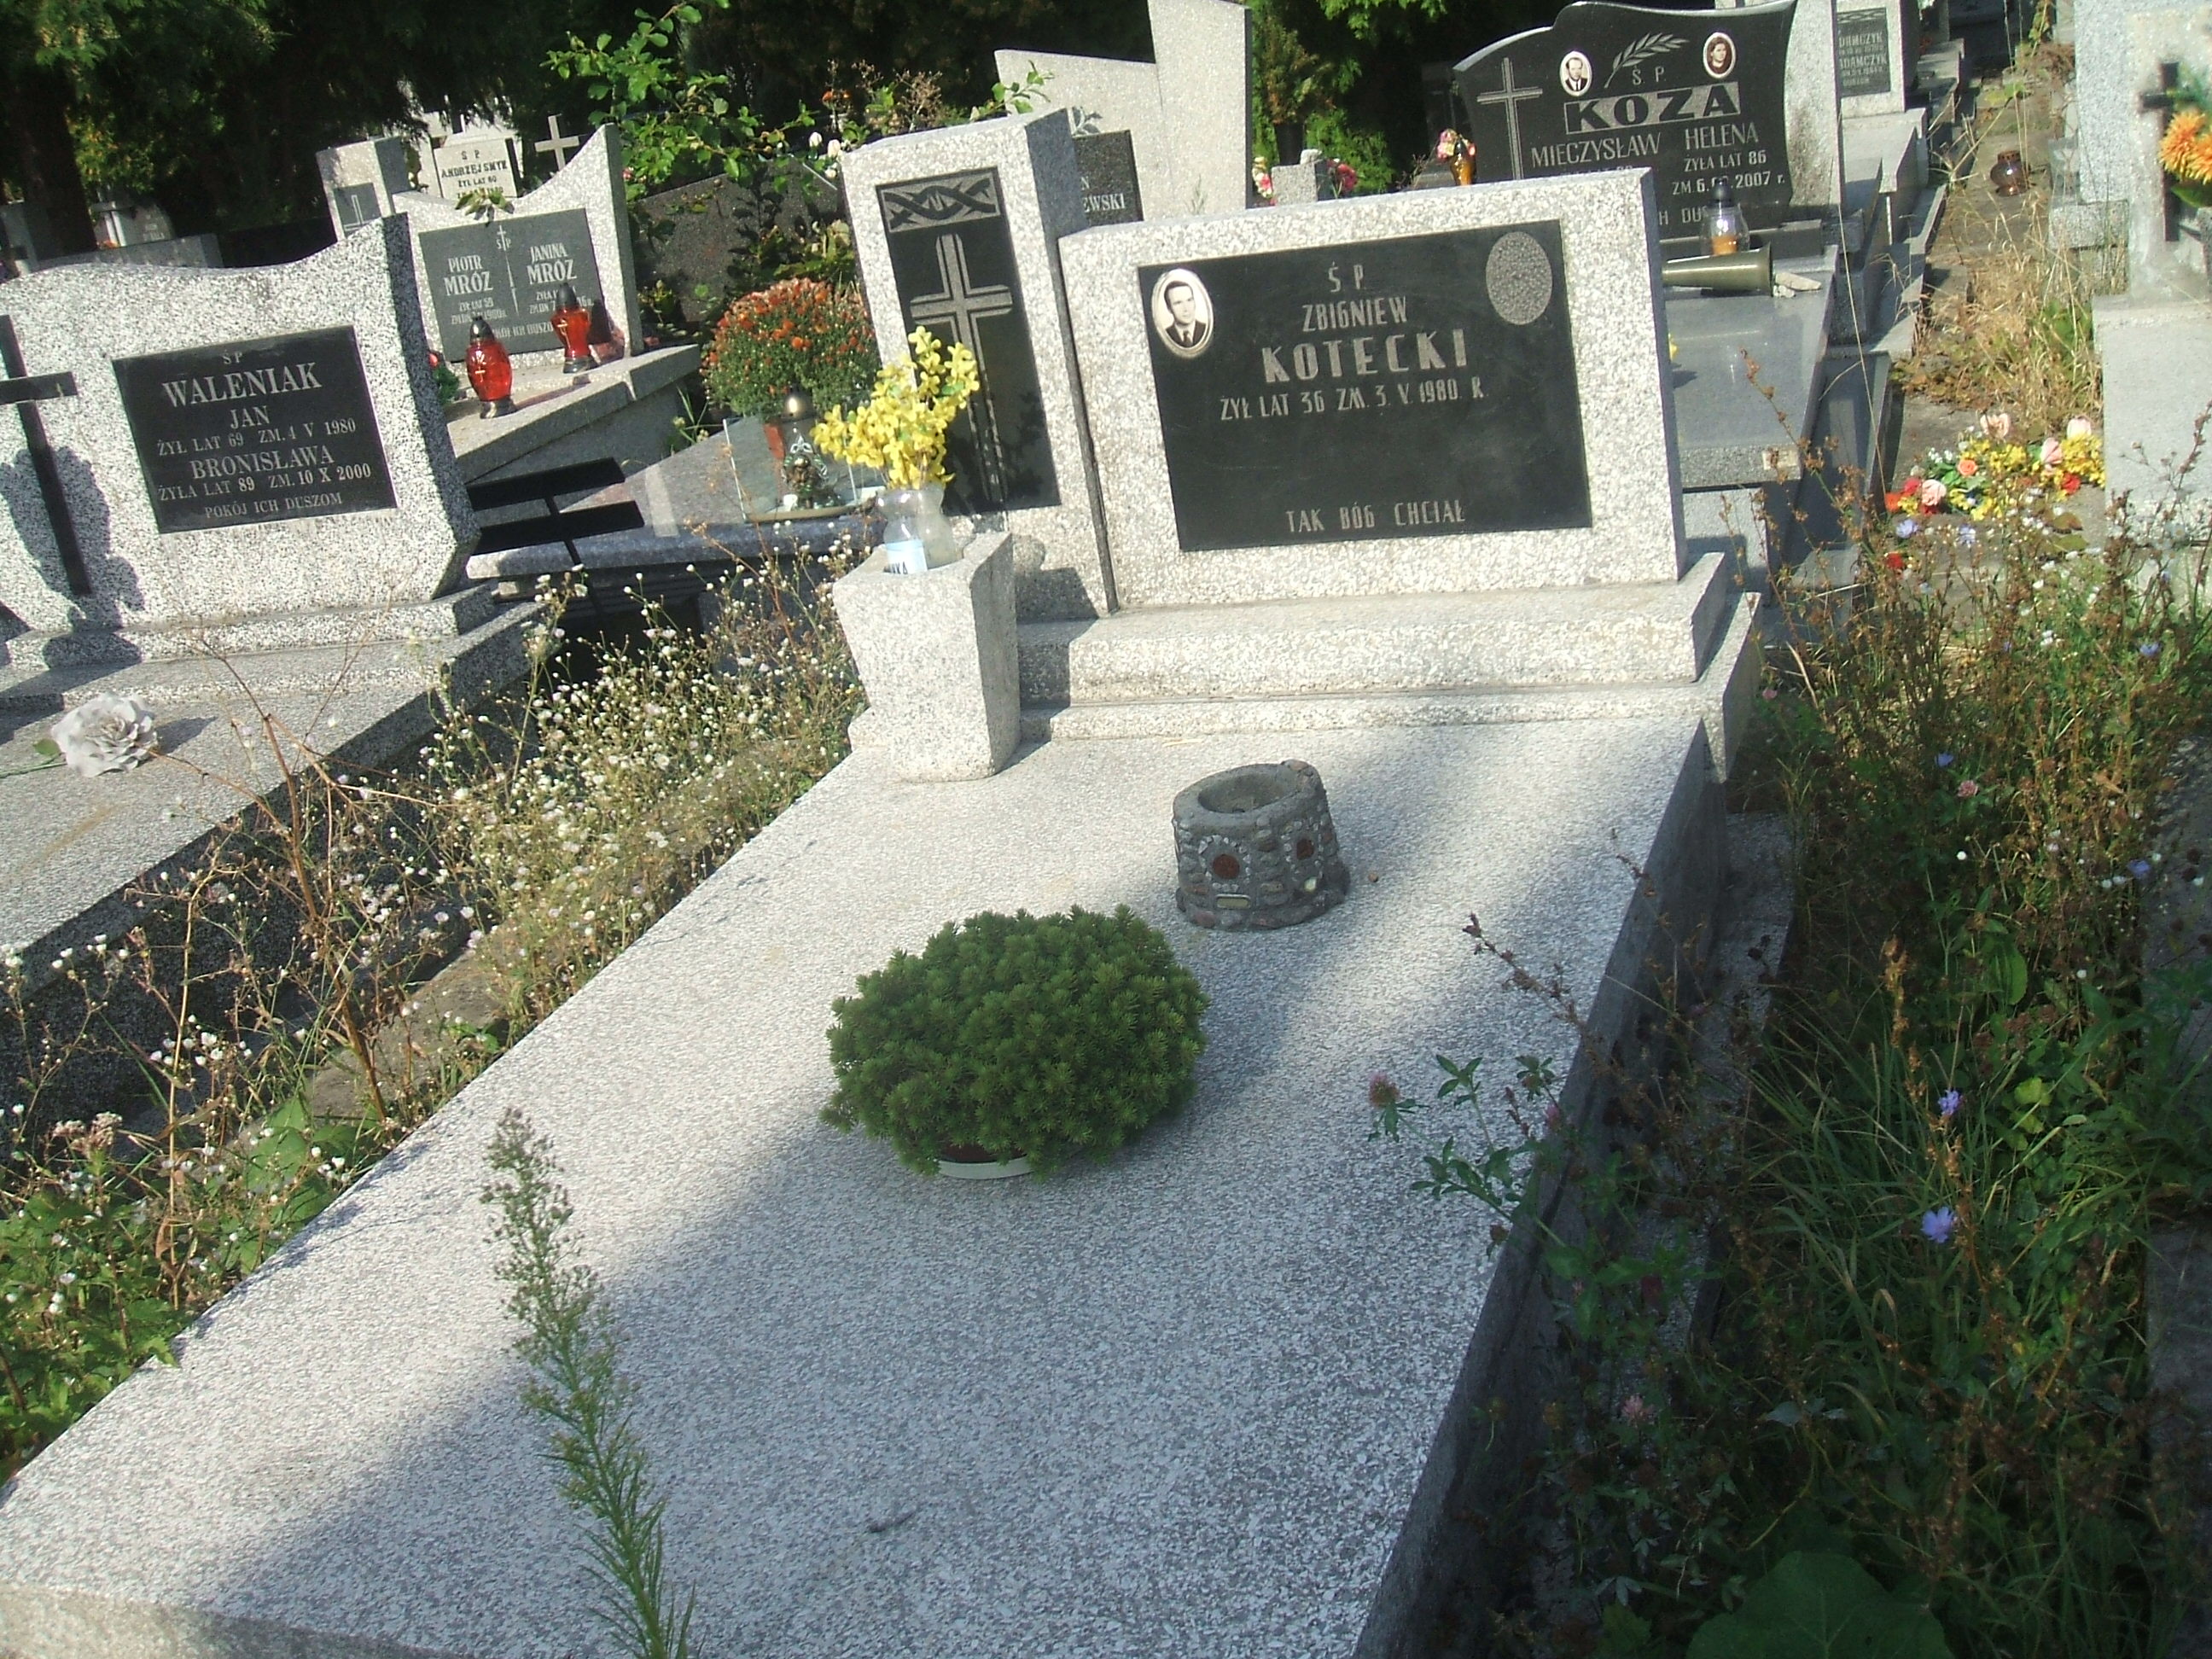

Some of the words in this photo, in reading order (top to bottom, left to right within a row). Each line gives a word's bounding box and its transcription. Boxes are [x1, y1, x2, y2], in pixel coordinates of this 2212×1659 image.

[1567, 83, 1739, 135] KOZA
[1531, 131, 1661, 168] MIECZYSŁAW
[1685, 121, 1759, 151] HELENA
[441, 163, 482, 178] ANDRZEJ
[1720, 153, 1742, 168] LAT
[1749, 149, 1767, 165] 86
[1082, 192, 1126, 213] EWSKI
[448, 254, 484, 273] PIOTR
[530, 242, 568, 265] JANINA
[444, 271, 494, 296] MRÓZ
[527, 259, 578, 285] MRÓZ
[1353, 264, 1364, 291] P
[1301, 295, 1409, 333] ZBIGNIEW
[526, 322, 554, 335] DUSZO
[1261, 329, 1468, 383] KOTECKI
[162, 362, 323, 408] WALENIAK
[230, 405, 271, 429] JAN
[1259, 393, 1289, 417] LAT
[1301, 390, 1324, 414] 36
[194, 434, 222, 452] LAT
[228, 432, 244, 448] 69
[304, 422, 315, 438] V
[325, 417, 357, 436] 1980
[189, 444, 335, 480] BRONISŁAWA
[204, 480, 233, 497] LAT
[238, 475, 255, 492] 89
[298, 470, 314, 486] 10
[320, 468, 332, 483] X
[336, 463, 372, 480] 2000
[205, 500, 247, 519] POKÓJ
[253, 498, 278, 514] ICH
[286, 492, 343, 511] DUSZOM
[1287, 507, 1325, 533] TAK
[1340, 502, 1376, 530] BÓG
[1395, 499, 1466, 527] CHCIAŁ
